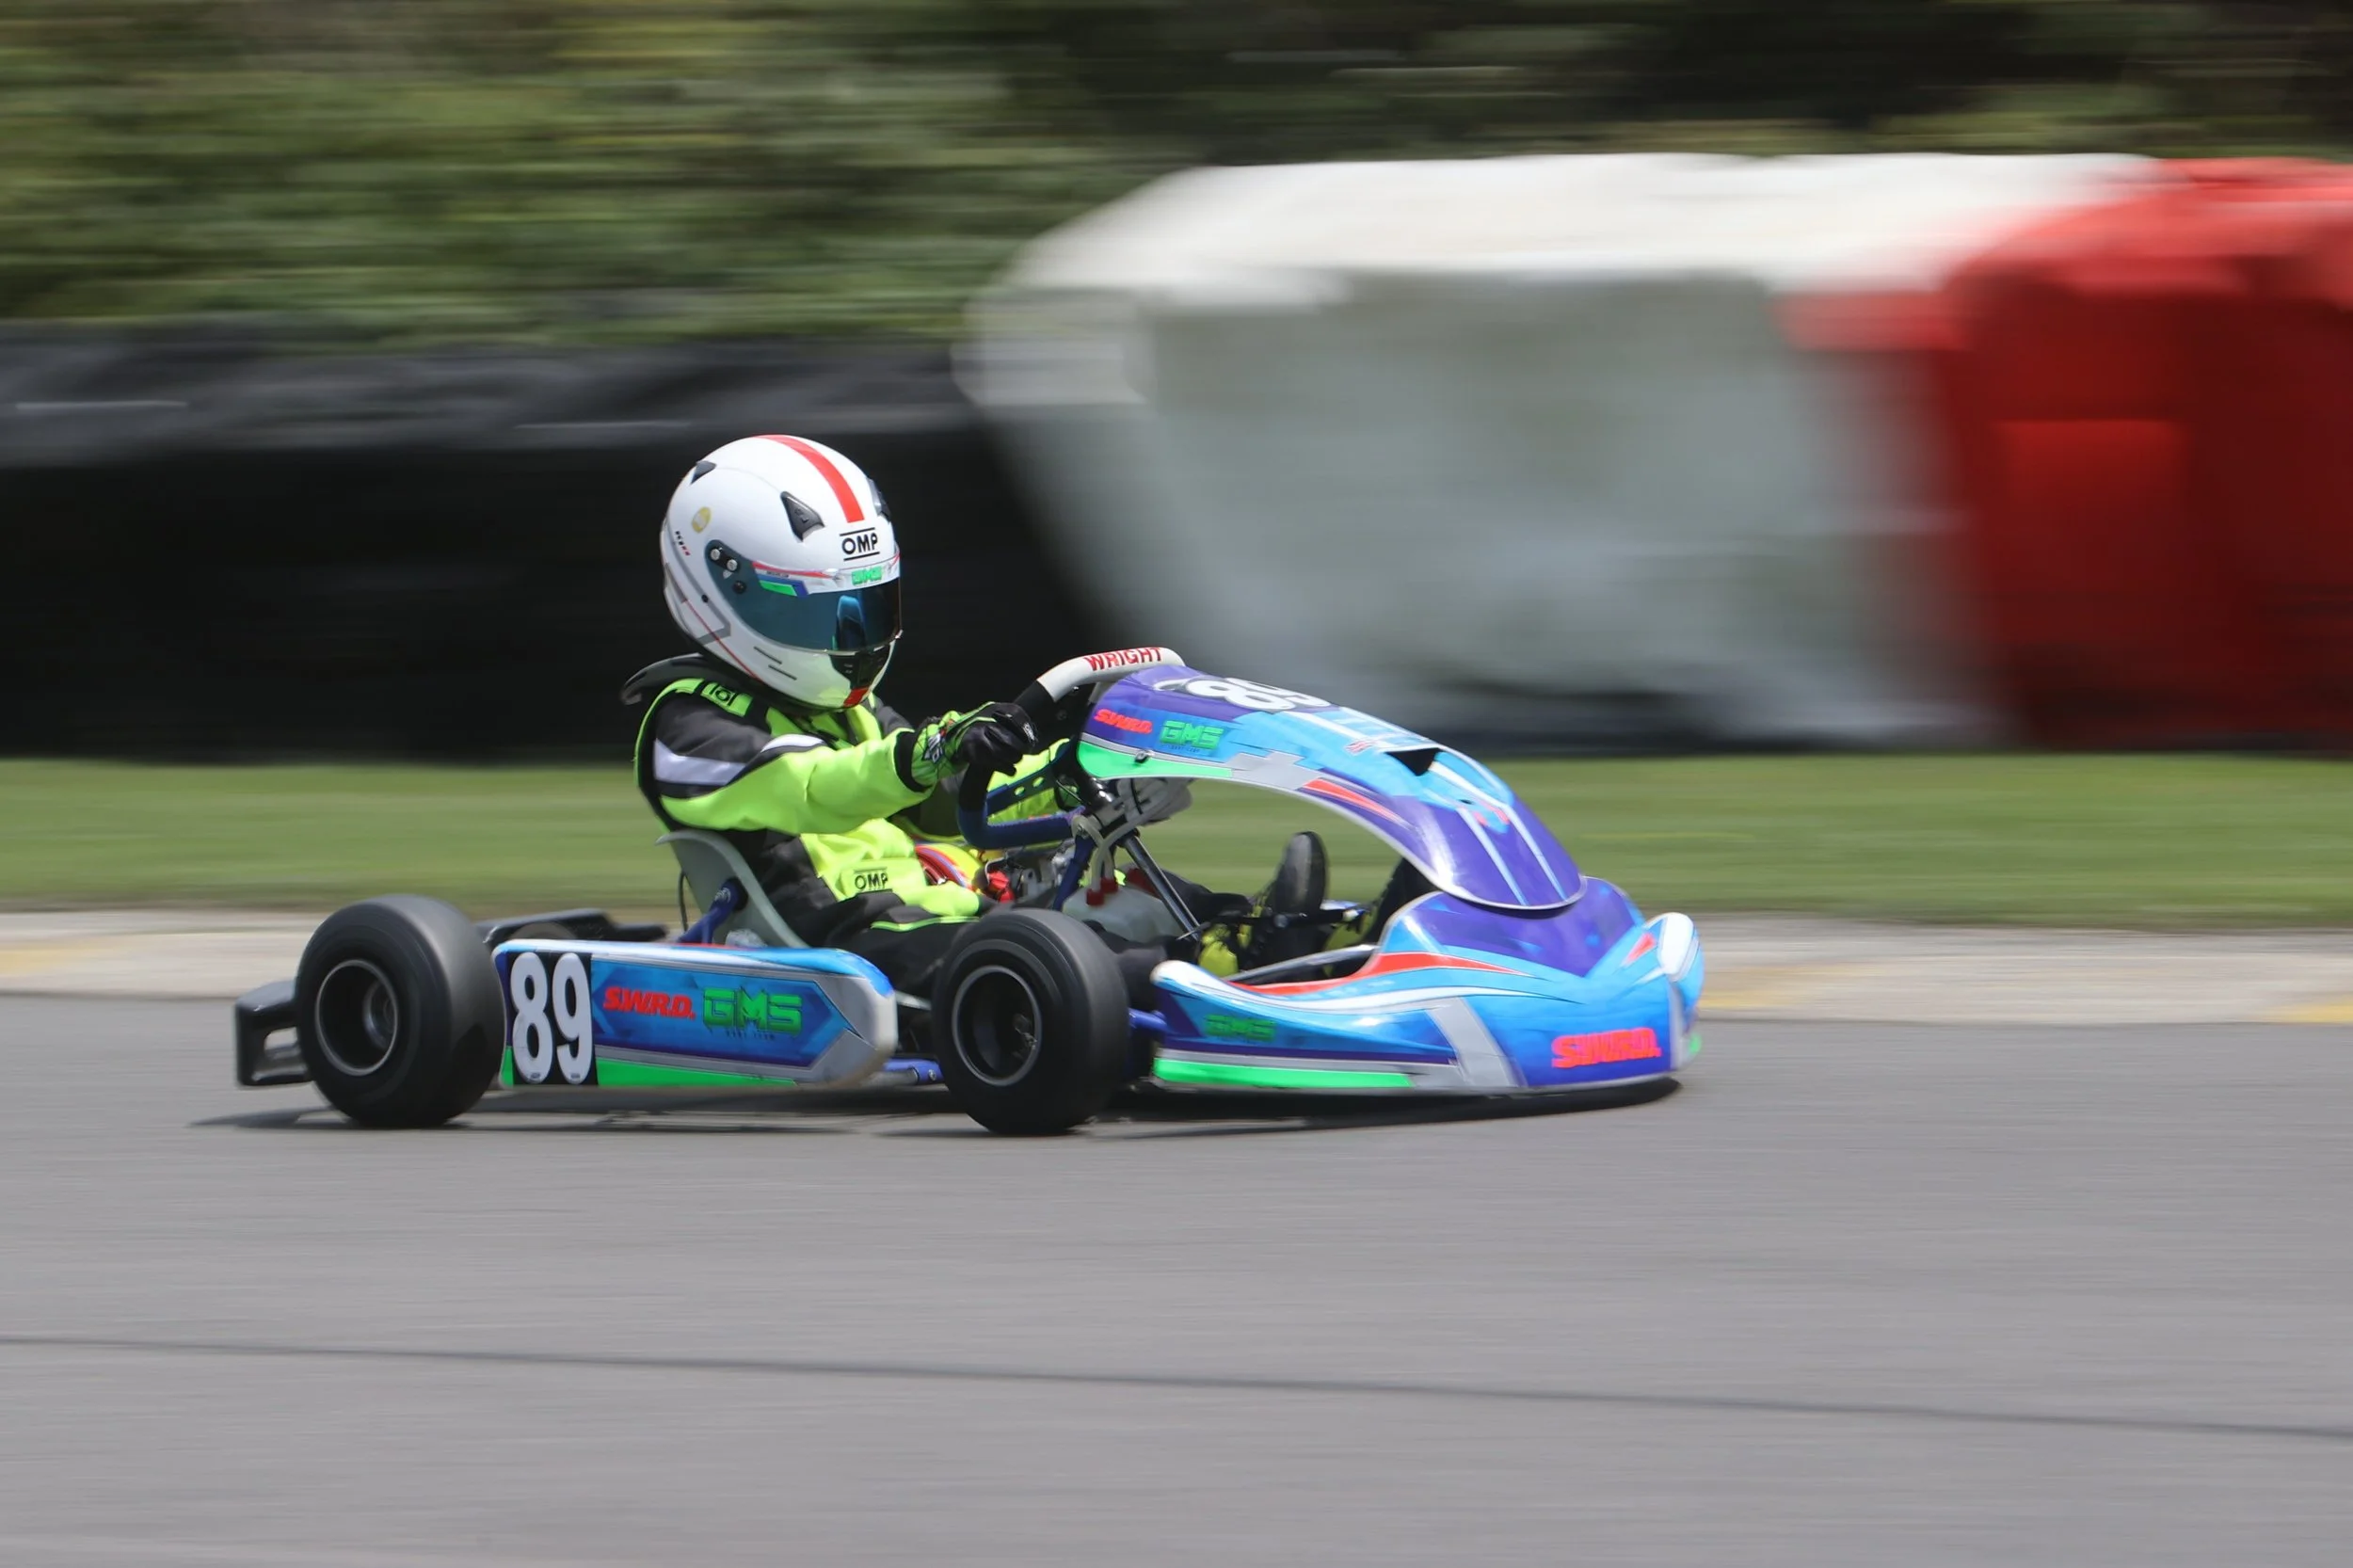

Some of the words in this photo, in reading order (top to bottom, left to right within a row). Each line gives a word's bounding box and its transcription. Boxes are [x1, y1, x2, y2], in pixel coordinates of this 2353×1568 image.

[841, 532, 878, 555] OMP
[1083, 647, 1162, 671] WRIGHT
[1160, 720, 1224, 750] GMS
[855, 872, 888, 890] OMP
[510, 952, 593, 1084] 89
[702, 987, 803, 1035] GMS
